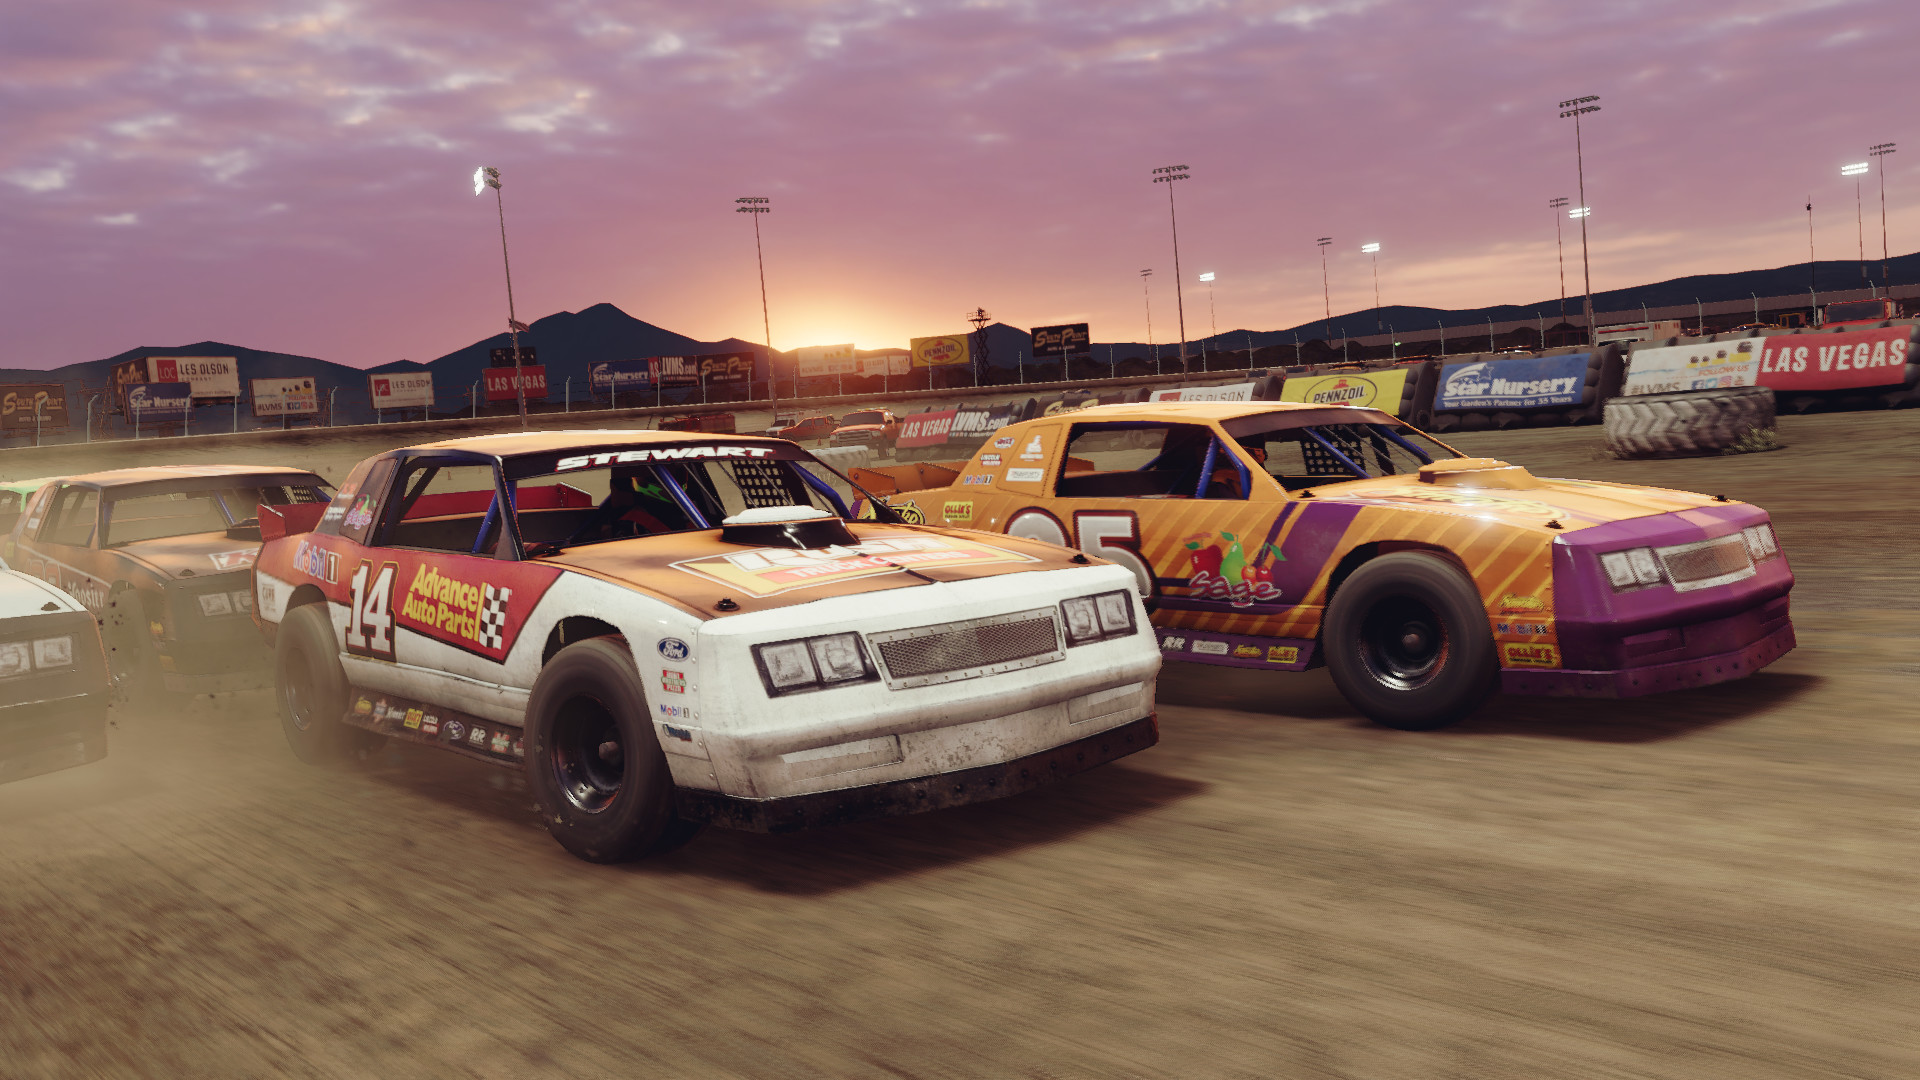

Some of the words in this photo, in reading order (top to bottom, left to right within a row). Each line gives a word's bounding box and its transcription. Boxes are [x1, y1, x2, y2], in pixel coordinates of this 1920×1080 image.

[924, 343, 956, 358] PENNZOIL
[1761, 346, 1808, 372] LAS
[1819, 338, 1906, 371] VEGAS
[159, 367, 176, 379] LOC
[180, 363, 197, 375] LES
[199, 362, 229, 375] OLSON
[662, 356, 697, 376] LVMS.com
[488, 377, 508, 391] LAS
[1313, 385, 1367, 404] PENNZOIL
[1443, 381, 1490, 397] Star
[1490, 376, 1578, 396] Nursery
[900, 422, 920, 438] LAS
[921, 418, 951, 437] VEGAS
[951, 411, 1010, 432] LVMS.com
[556, 446, 773, 471] STEWART
[293, 540, 327, 580] Mobil
[785, 560, 867, 579] TRUCK
[866, 549, 971, 567] CENTERS
[409, 563, 478, 612] Advance
[1189, 571, 1283, 608] Sage
[347, 561, 398, 661] 14
[402, 592, 436, 626] Auto
[436, 602, 476, 641] Parts
[663, 641, 684, 658] Ford
[660, 704, 682, 718] Mobil
